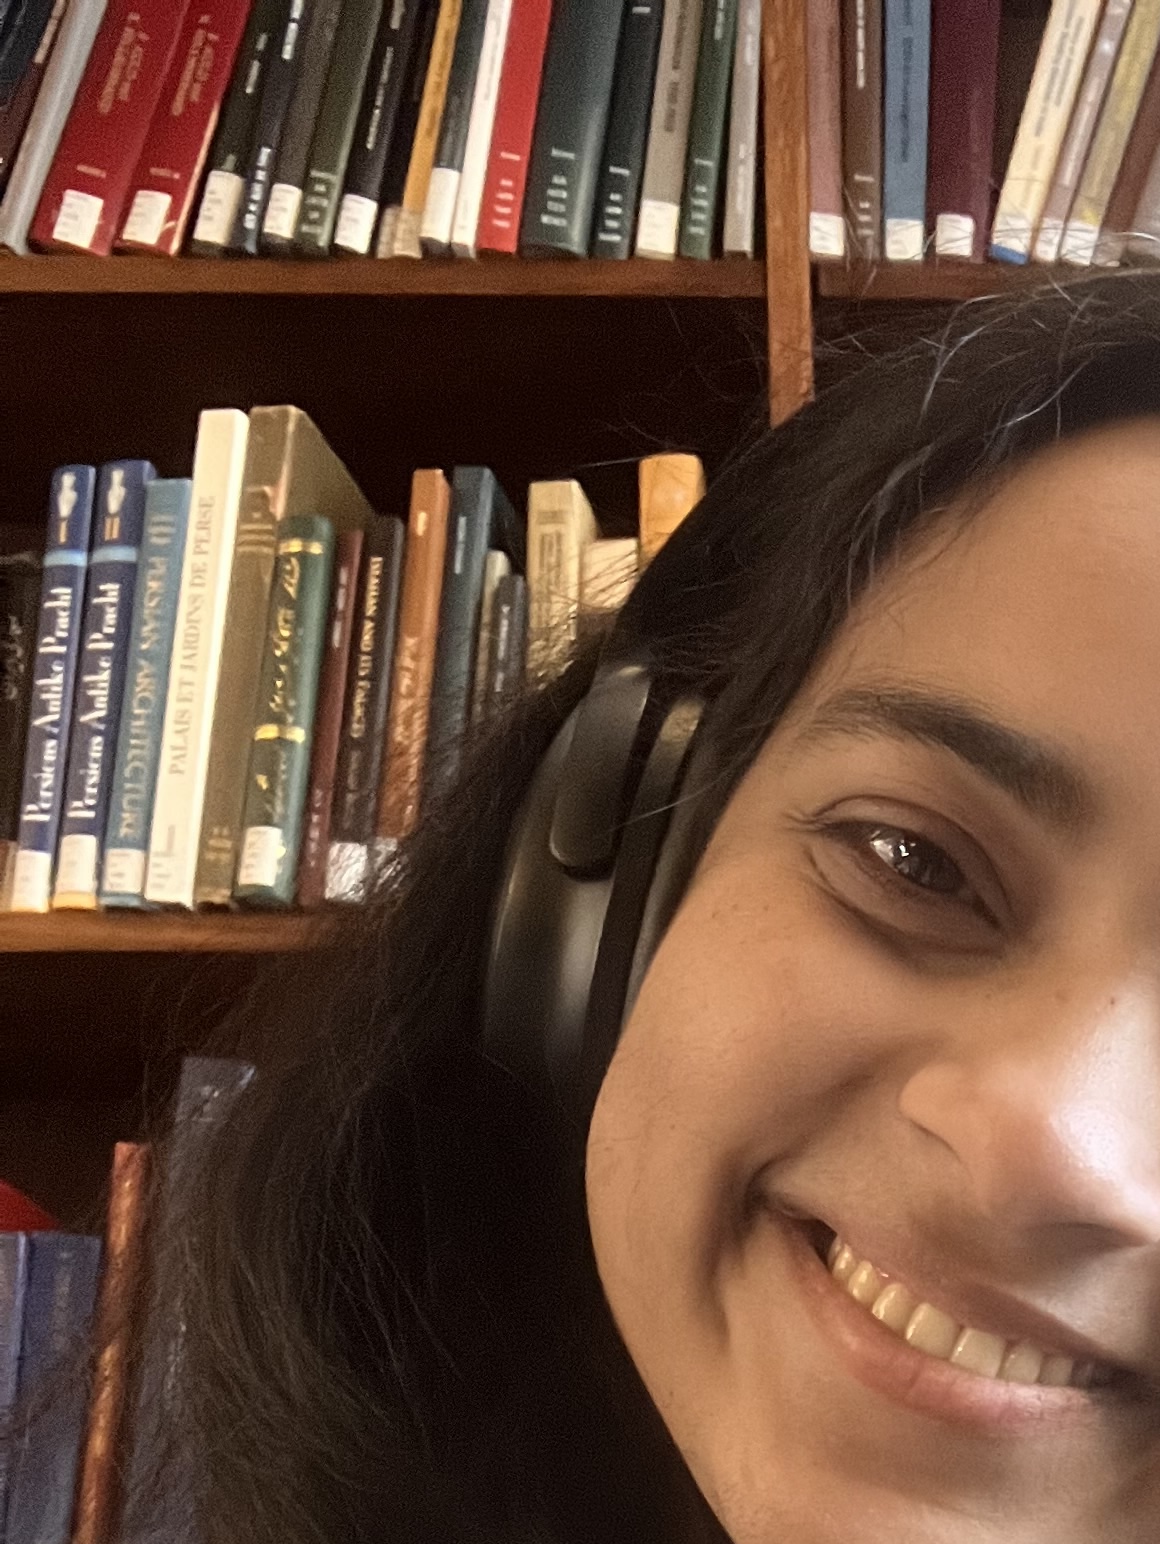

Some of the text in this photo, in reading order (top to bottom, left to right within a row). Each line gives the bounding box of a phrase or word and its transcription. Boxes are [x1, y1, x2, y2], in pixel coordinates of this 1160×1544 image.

[21, 587, 73, 822] Persiens Antike Pracht
[67, 583, 121, 818] Persiens Antike Pracht
[140, 557, 168, 650] PERSIAN
[168, 495, 216, 775] PALAIS ET JARDINS DE PERSE
[119, 658, 157, 838] ARCHITECTURE
